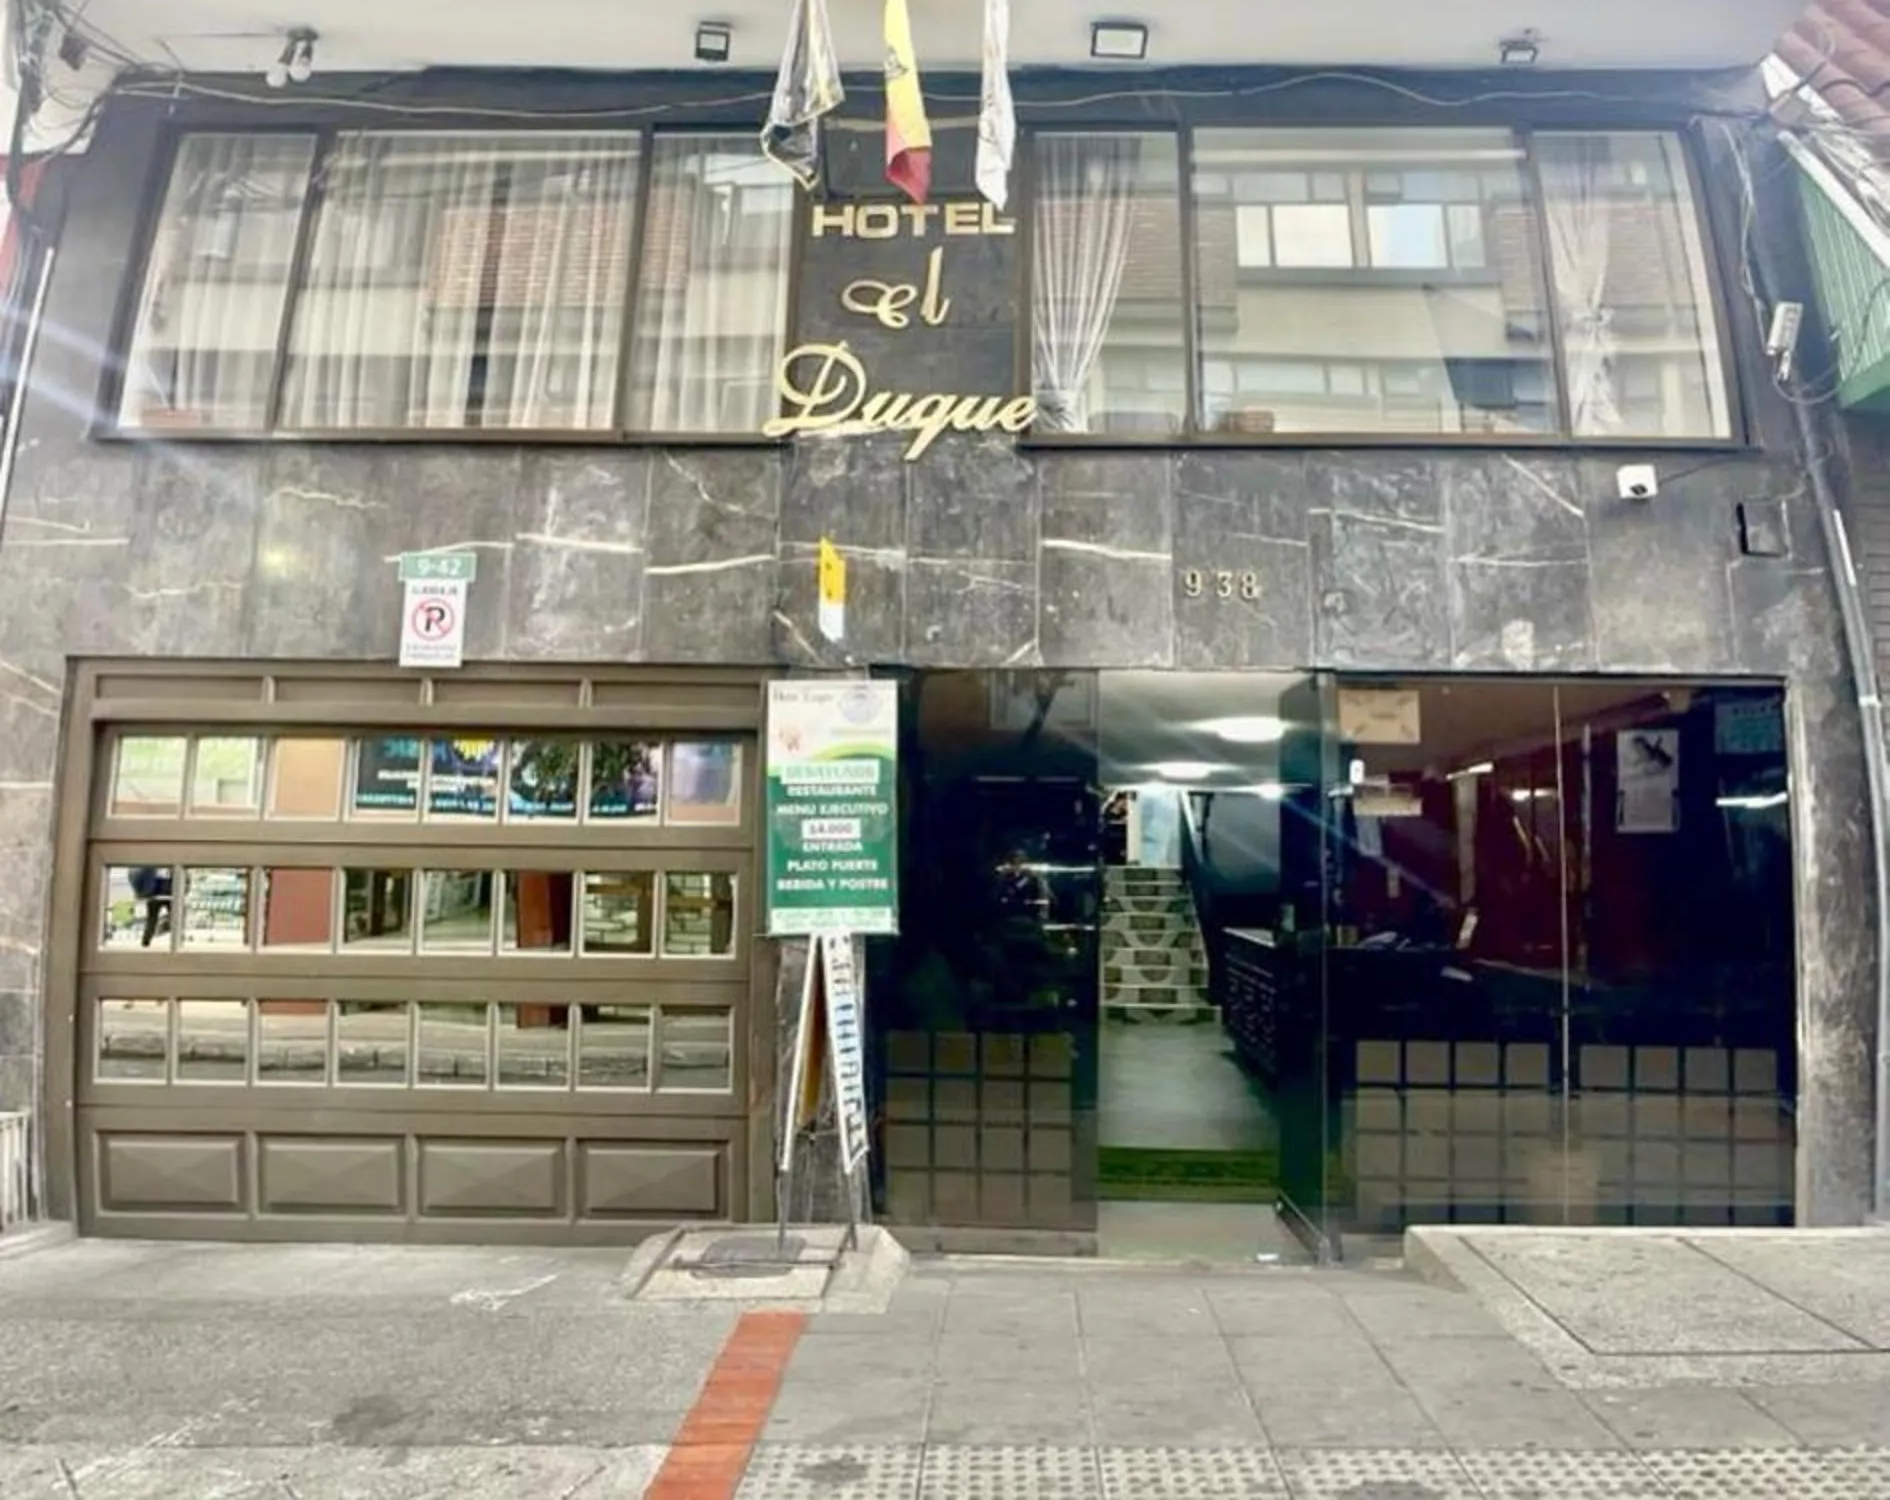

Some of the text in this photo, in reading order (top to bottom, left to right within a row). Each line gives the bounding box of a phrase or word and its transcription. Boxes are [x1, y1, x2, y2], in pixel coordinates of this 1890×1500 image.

[811, 202, 1016, 239] HOTEL
[761, 340, 1040, 461] Duque
[786, 784, 877, 797] RESTAURANTE
[776, 803, 889, 816] MENU EJECUTIVO
[802, 840, 863, 853] ENTRADA
[786, 858, 878, 872] PLATO FUERTE
[776, 877, 888, 891] BEBIDA Y POSTRE
